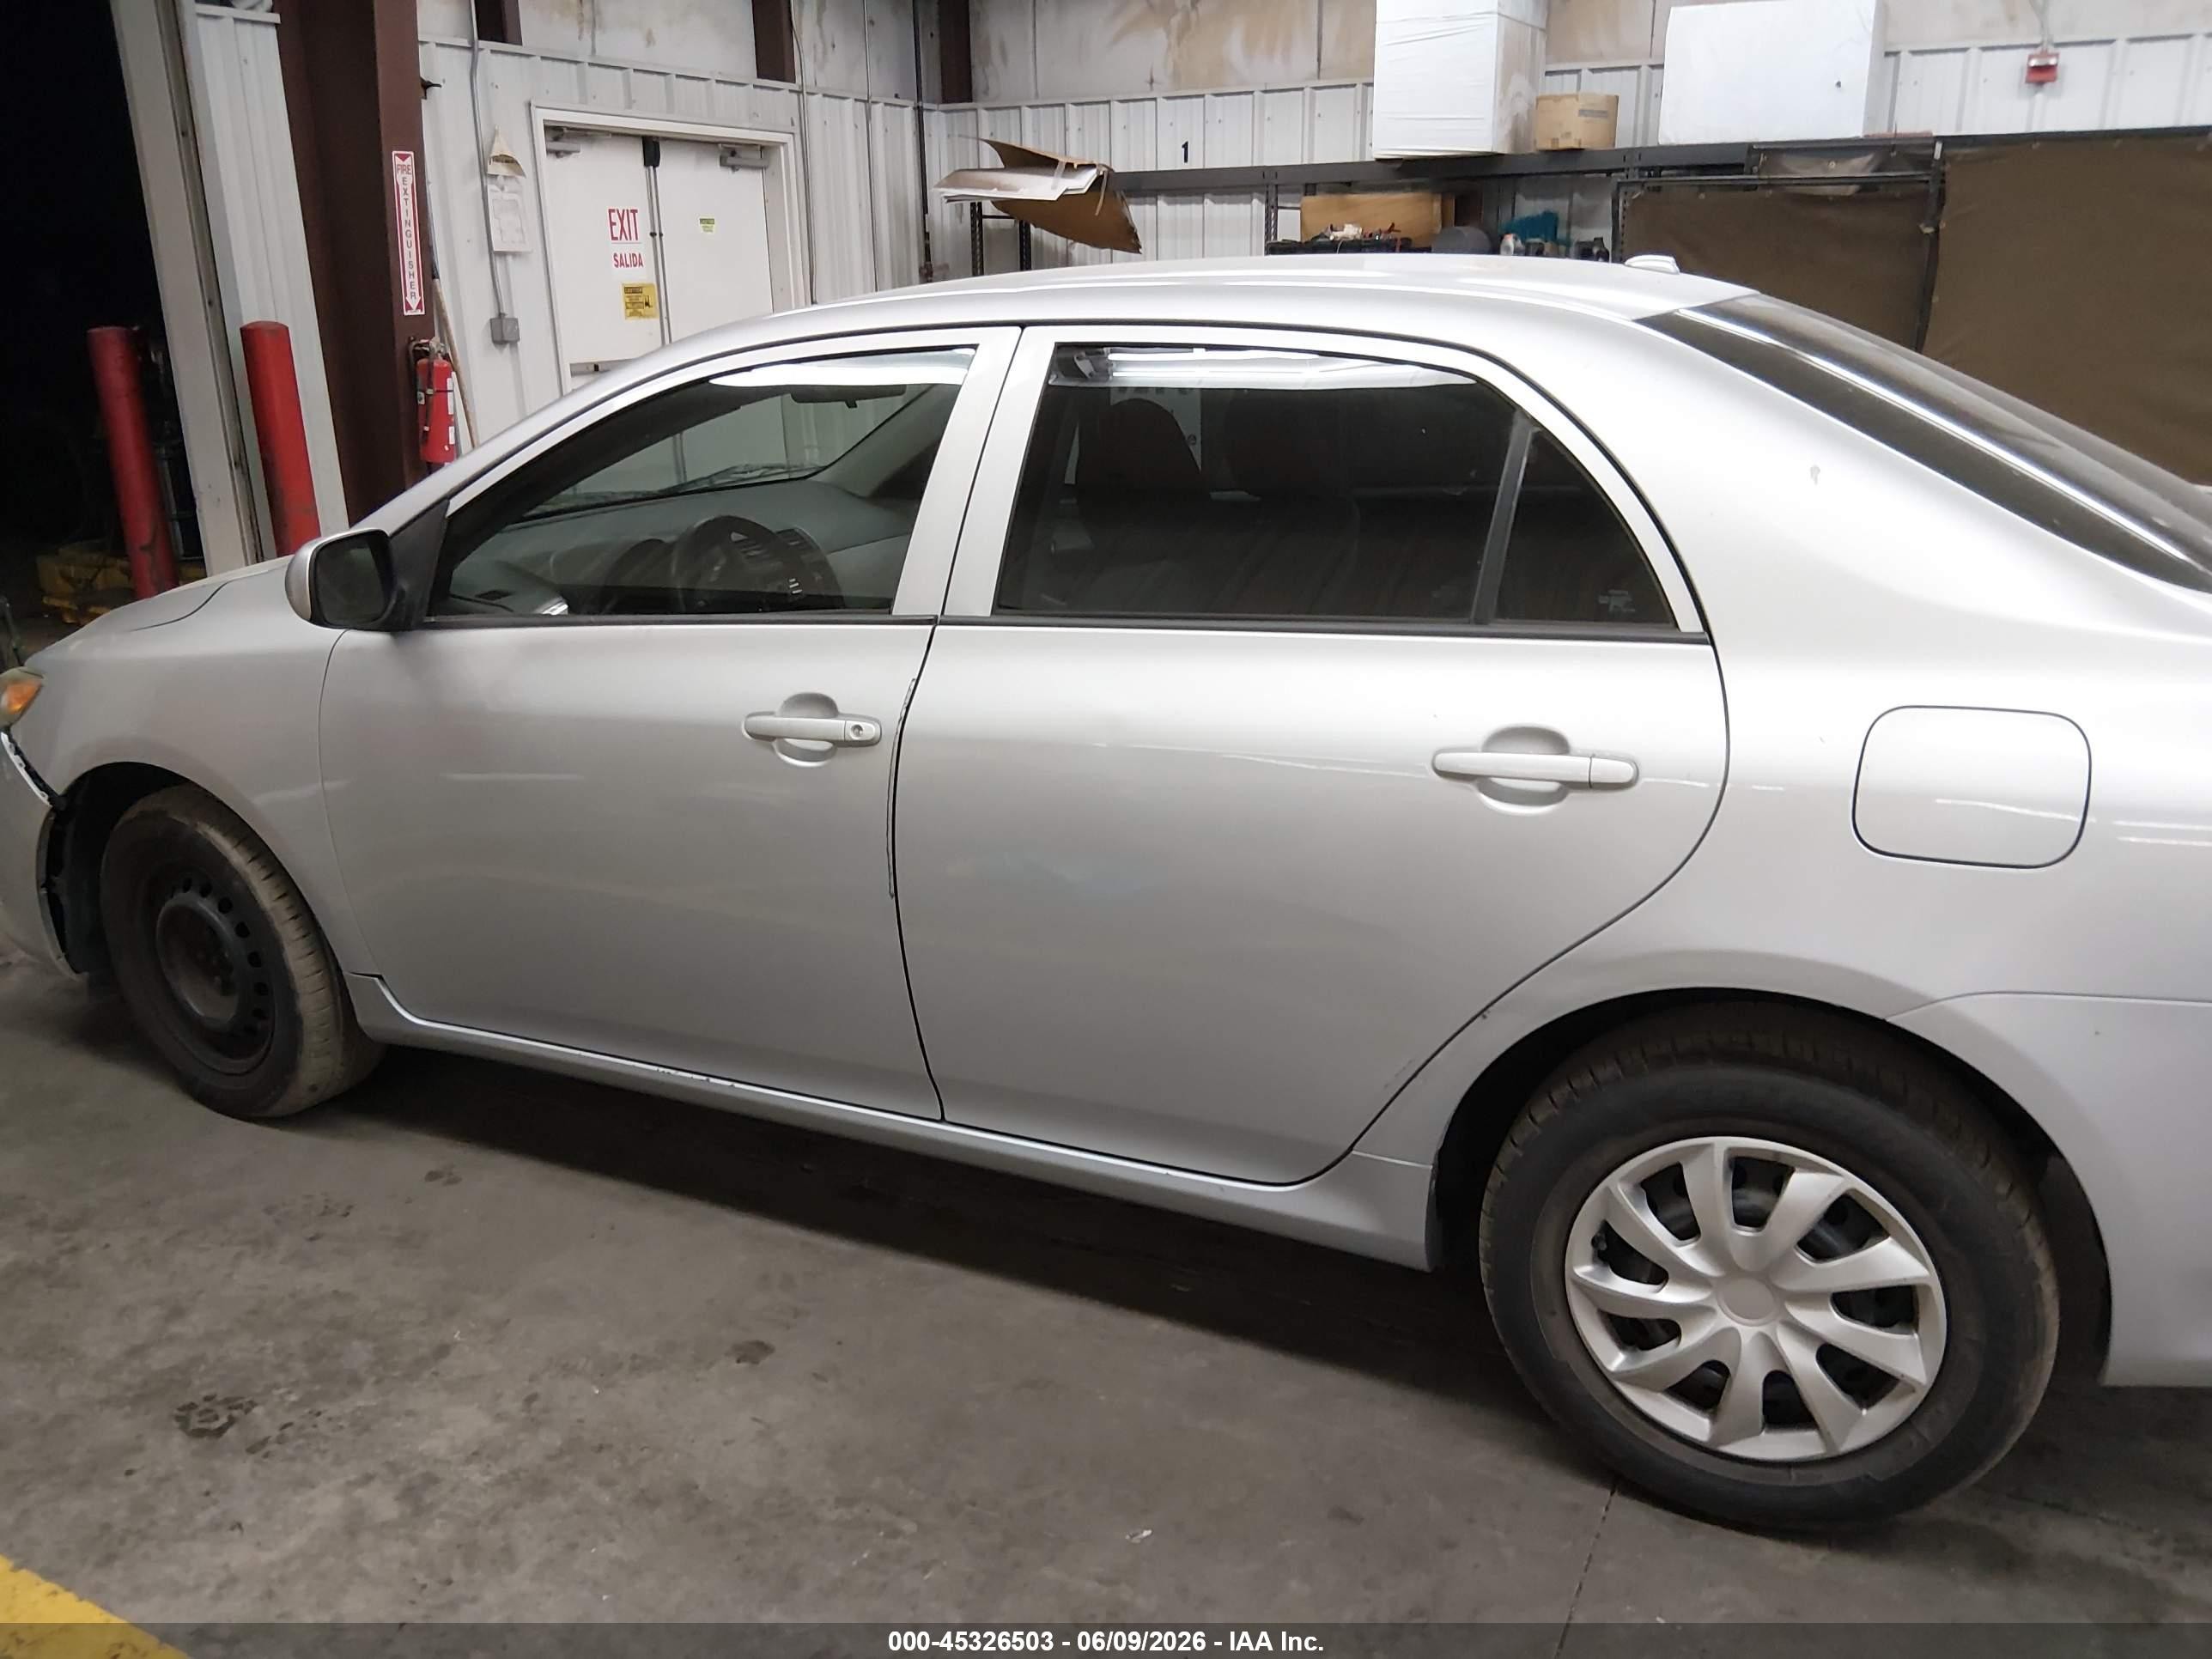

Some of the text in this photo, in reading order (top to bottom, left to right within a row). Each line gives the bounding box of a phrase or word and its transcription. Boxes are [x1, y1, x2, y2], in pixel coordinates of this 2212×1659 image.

[1181, 140, 1189, 163] 1
[397, 164, 412, 175] FIRE
[608, 209, 639, 241] EXIT
[401, 177, 416, 300] EXTINGUISHER
[613, 252, 644, 268] SALIDA
